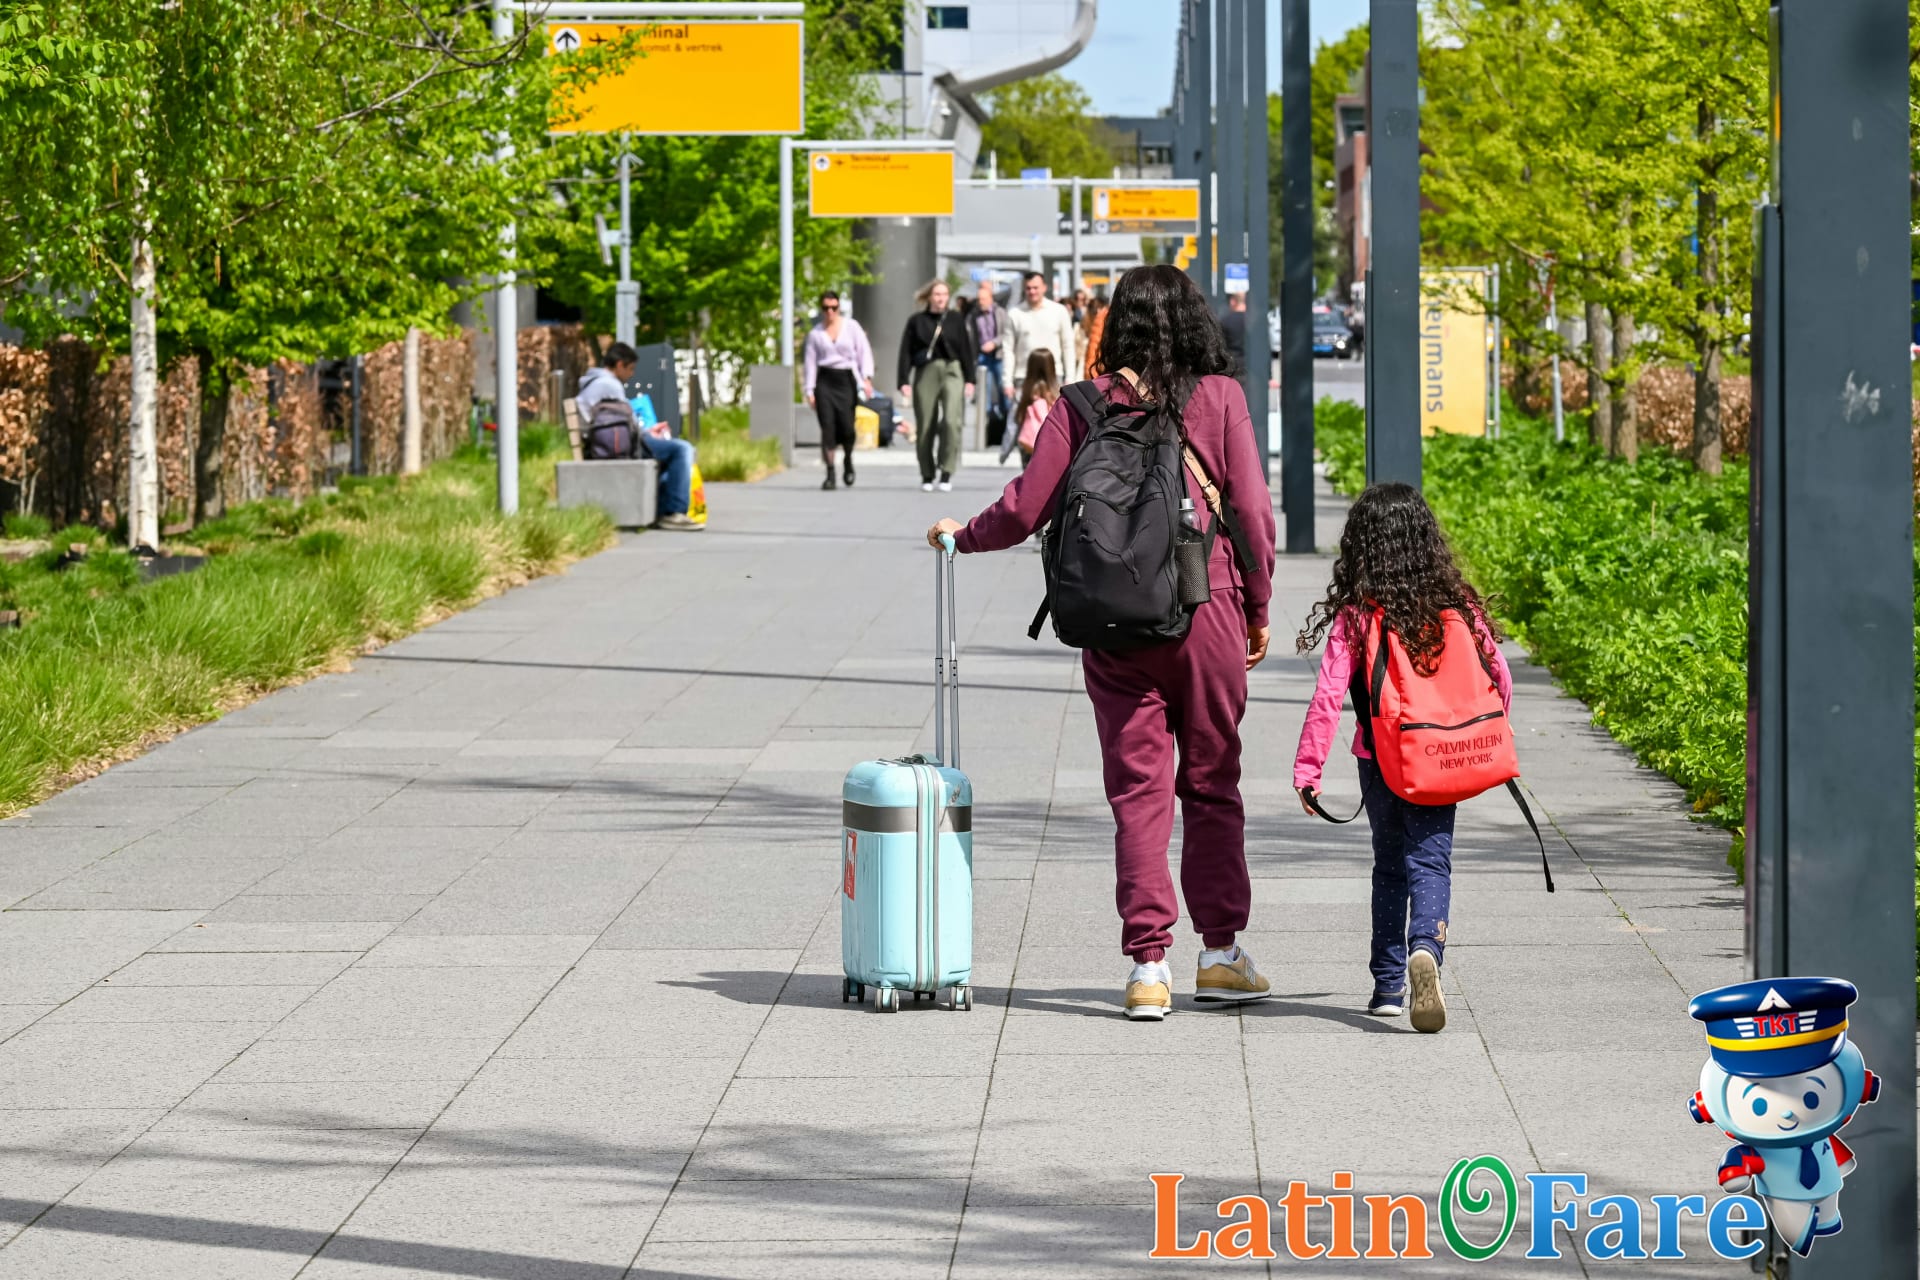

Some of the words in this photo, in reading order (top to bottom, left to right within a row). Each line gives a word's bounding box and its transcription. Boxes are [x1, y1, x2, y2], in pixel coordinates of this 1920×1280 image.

[685, 43, 723, 52] vertrek
[1425, 738, 1471, 757] CALVIN
[1473, 732, 1503, 751] KLEIN
[1440, 756, 1465, 770] NEW
[1466, 752, 1493, 767] YORK
